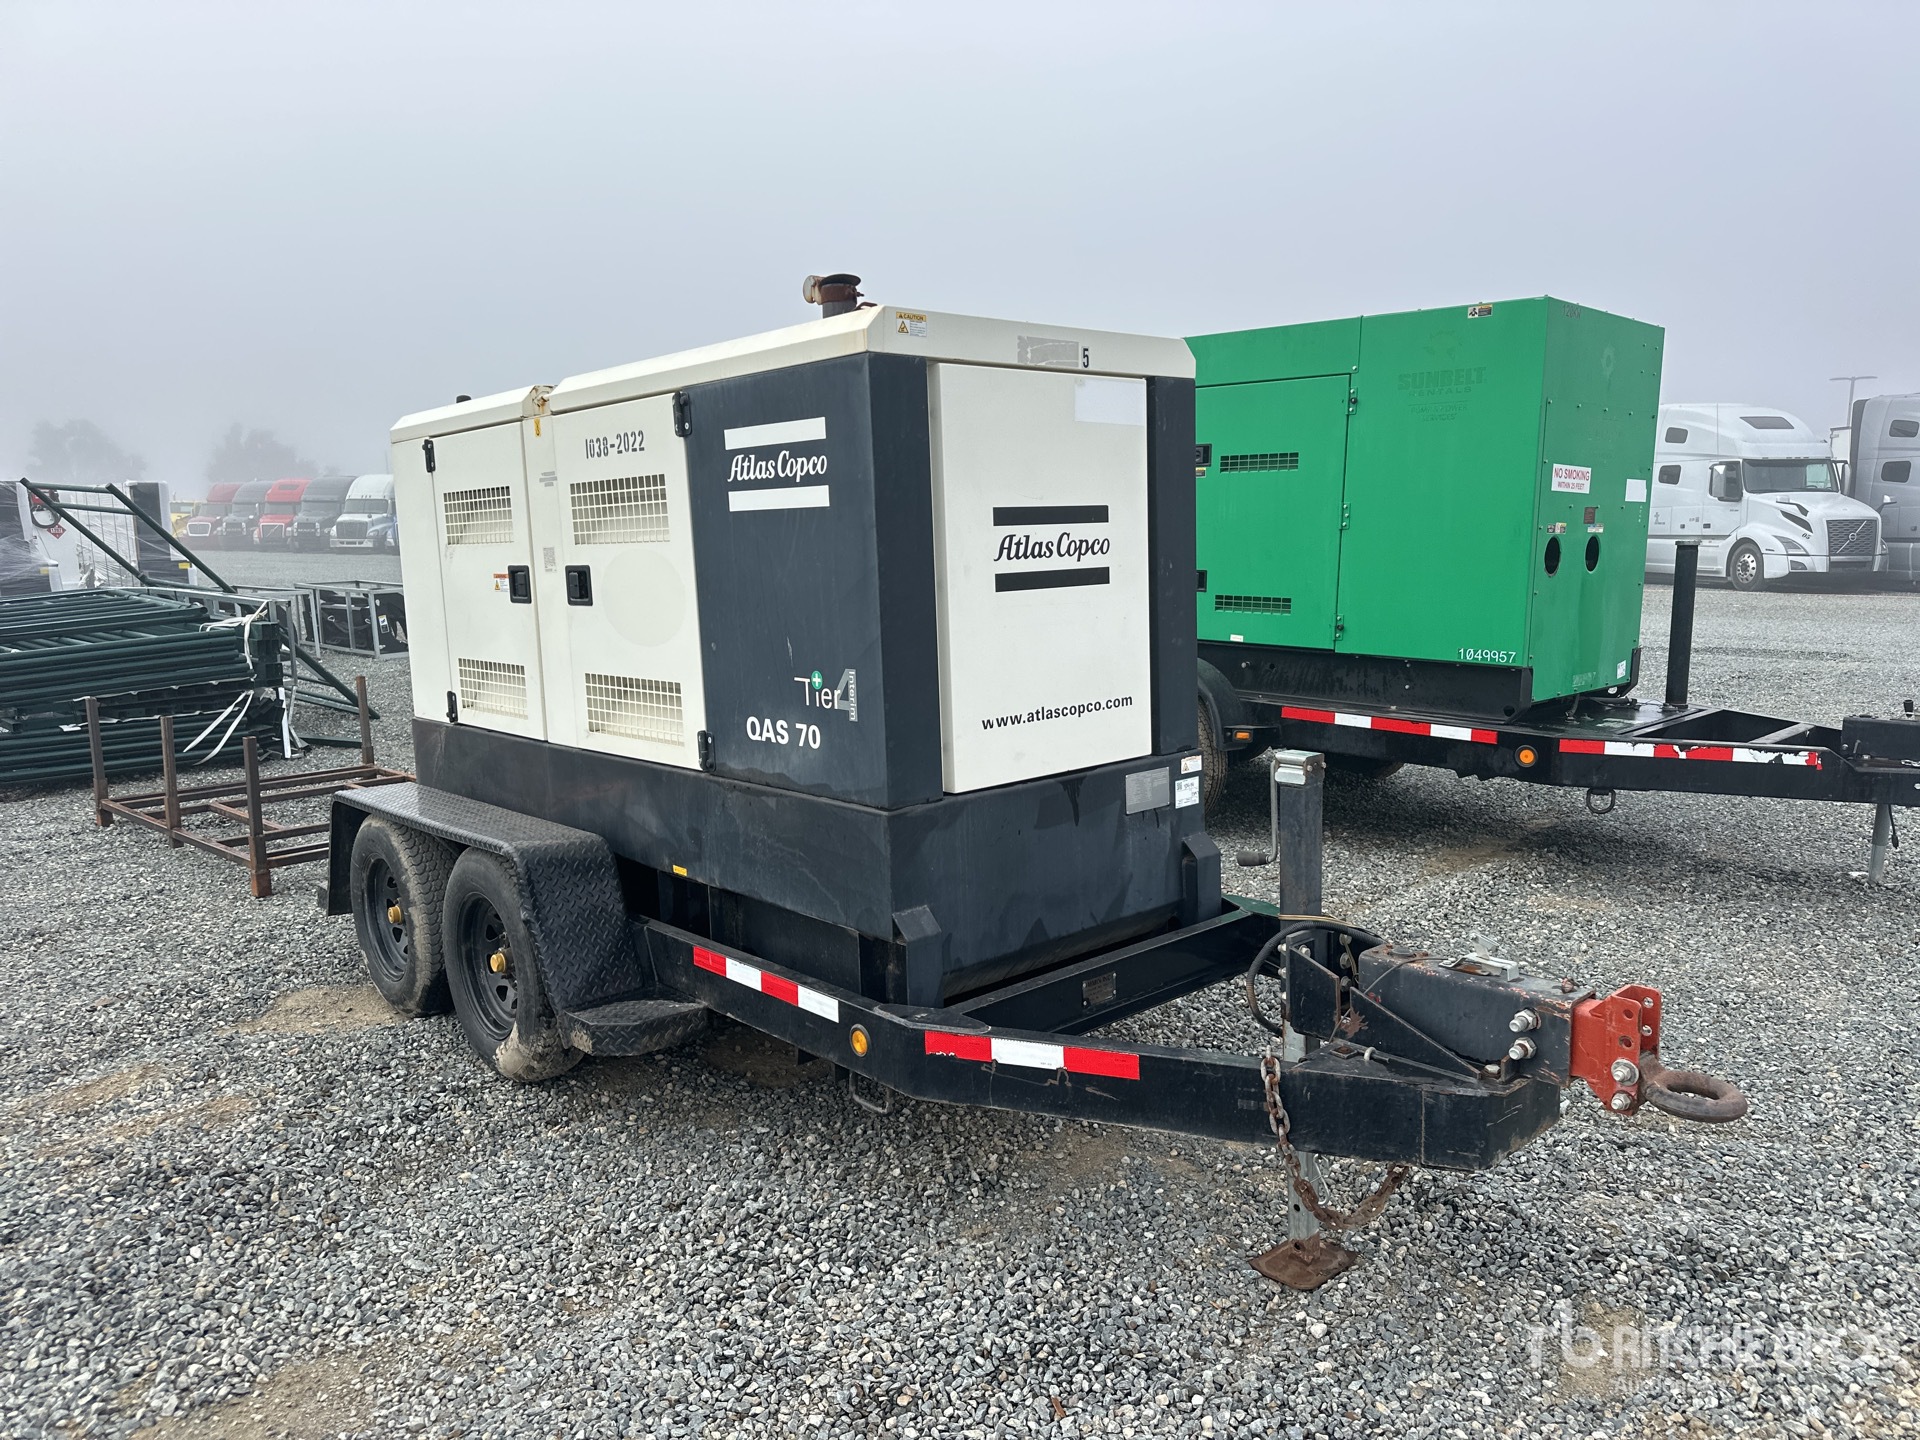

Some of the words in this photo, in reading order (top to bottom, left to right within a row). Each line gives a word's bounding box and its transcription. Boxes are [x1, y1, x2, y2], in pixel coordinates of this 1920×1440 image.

[904, 313, 924, 321] CAUTION
[1082, 347, 1090, 369] 5
[1397, 366, 1487, 391] SUNBELT
[1408, 385, 1473, 398] RENTALS
[584, 430, 645, 460] 1038-2022
[727, 453, 775, 483] Atlas
[776, 450, 828, 483] Copco
[1554, 467, 1563, 479] NO
[1564, 468, 1590, 481] SMOKING
[1557, 481, 1570, 489] WITHIN
[993, 534, 1054, 562] Atlas
[1056, 532, 1110, 562] Copco
[1458, 647, 1517, 664] 1049957
[793, 670, 841, 710] Tier
[847, 671, 857, 720] Interim
[981, 696, 1133, 730] www.atlascopco.com
[746, 716, 789, 745] QAS
[795, 722, 821, 749] 70
